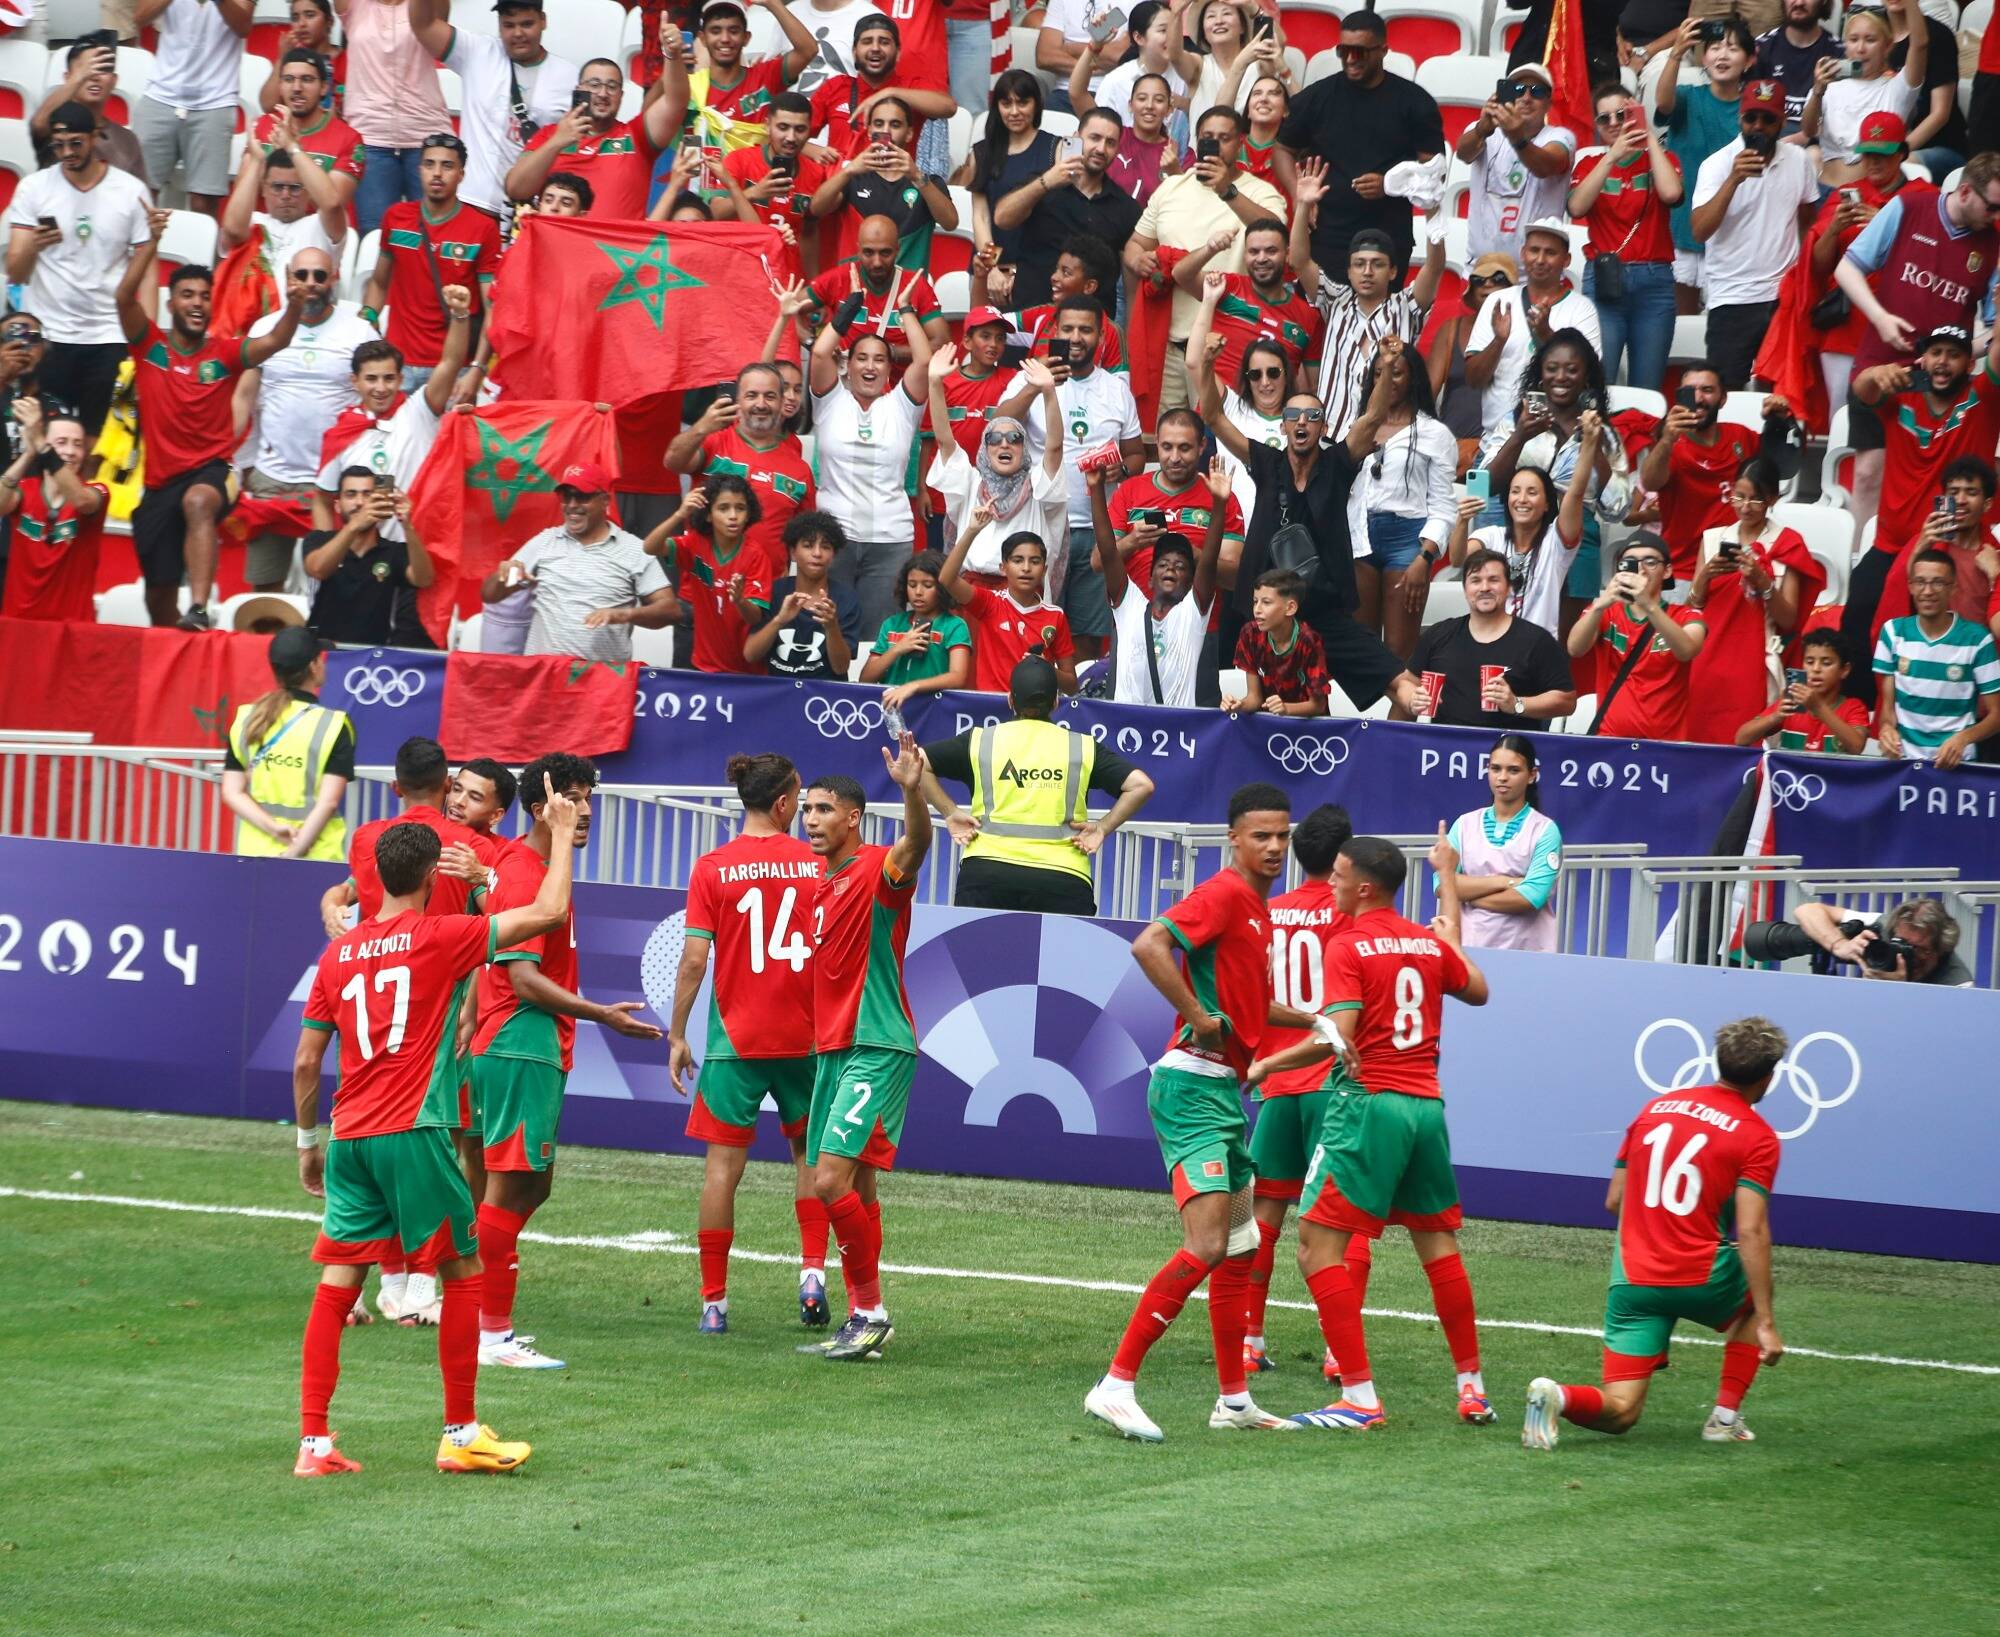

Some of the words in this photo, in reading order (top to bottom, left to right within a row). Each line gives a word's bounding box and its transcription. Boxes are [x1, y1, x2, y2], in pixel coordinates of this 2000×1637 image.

[1500, 206, 1520, 233] 2
[1900, 262, 1970, 306] ROVER
[1560, 759, 1669, 794] 2024
[718, 861, 820, 884] TARGHALLINE
[338, 944, 353, 963] EL
[356, 932, 412, 960] AZZOUZI
[736, 886, 812, 974] 14
[1354, 940, 1377, 958] EL
[1271, 928, 1325, 1014] 10
[341, 965, 411, 1061] 17
[1391, 966, 1425, 1051] 8
[844, 1082, 872, 1126] 2
[1642, 1121, 1709, 1216] 16
